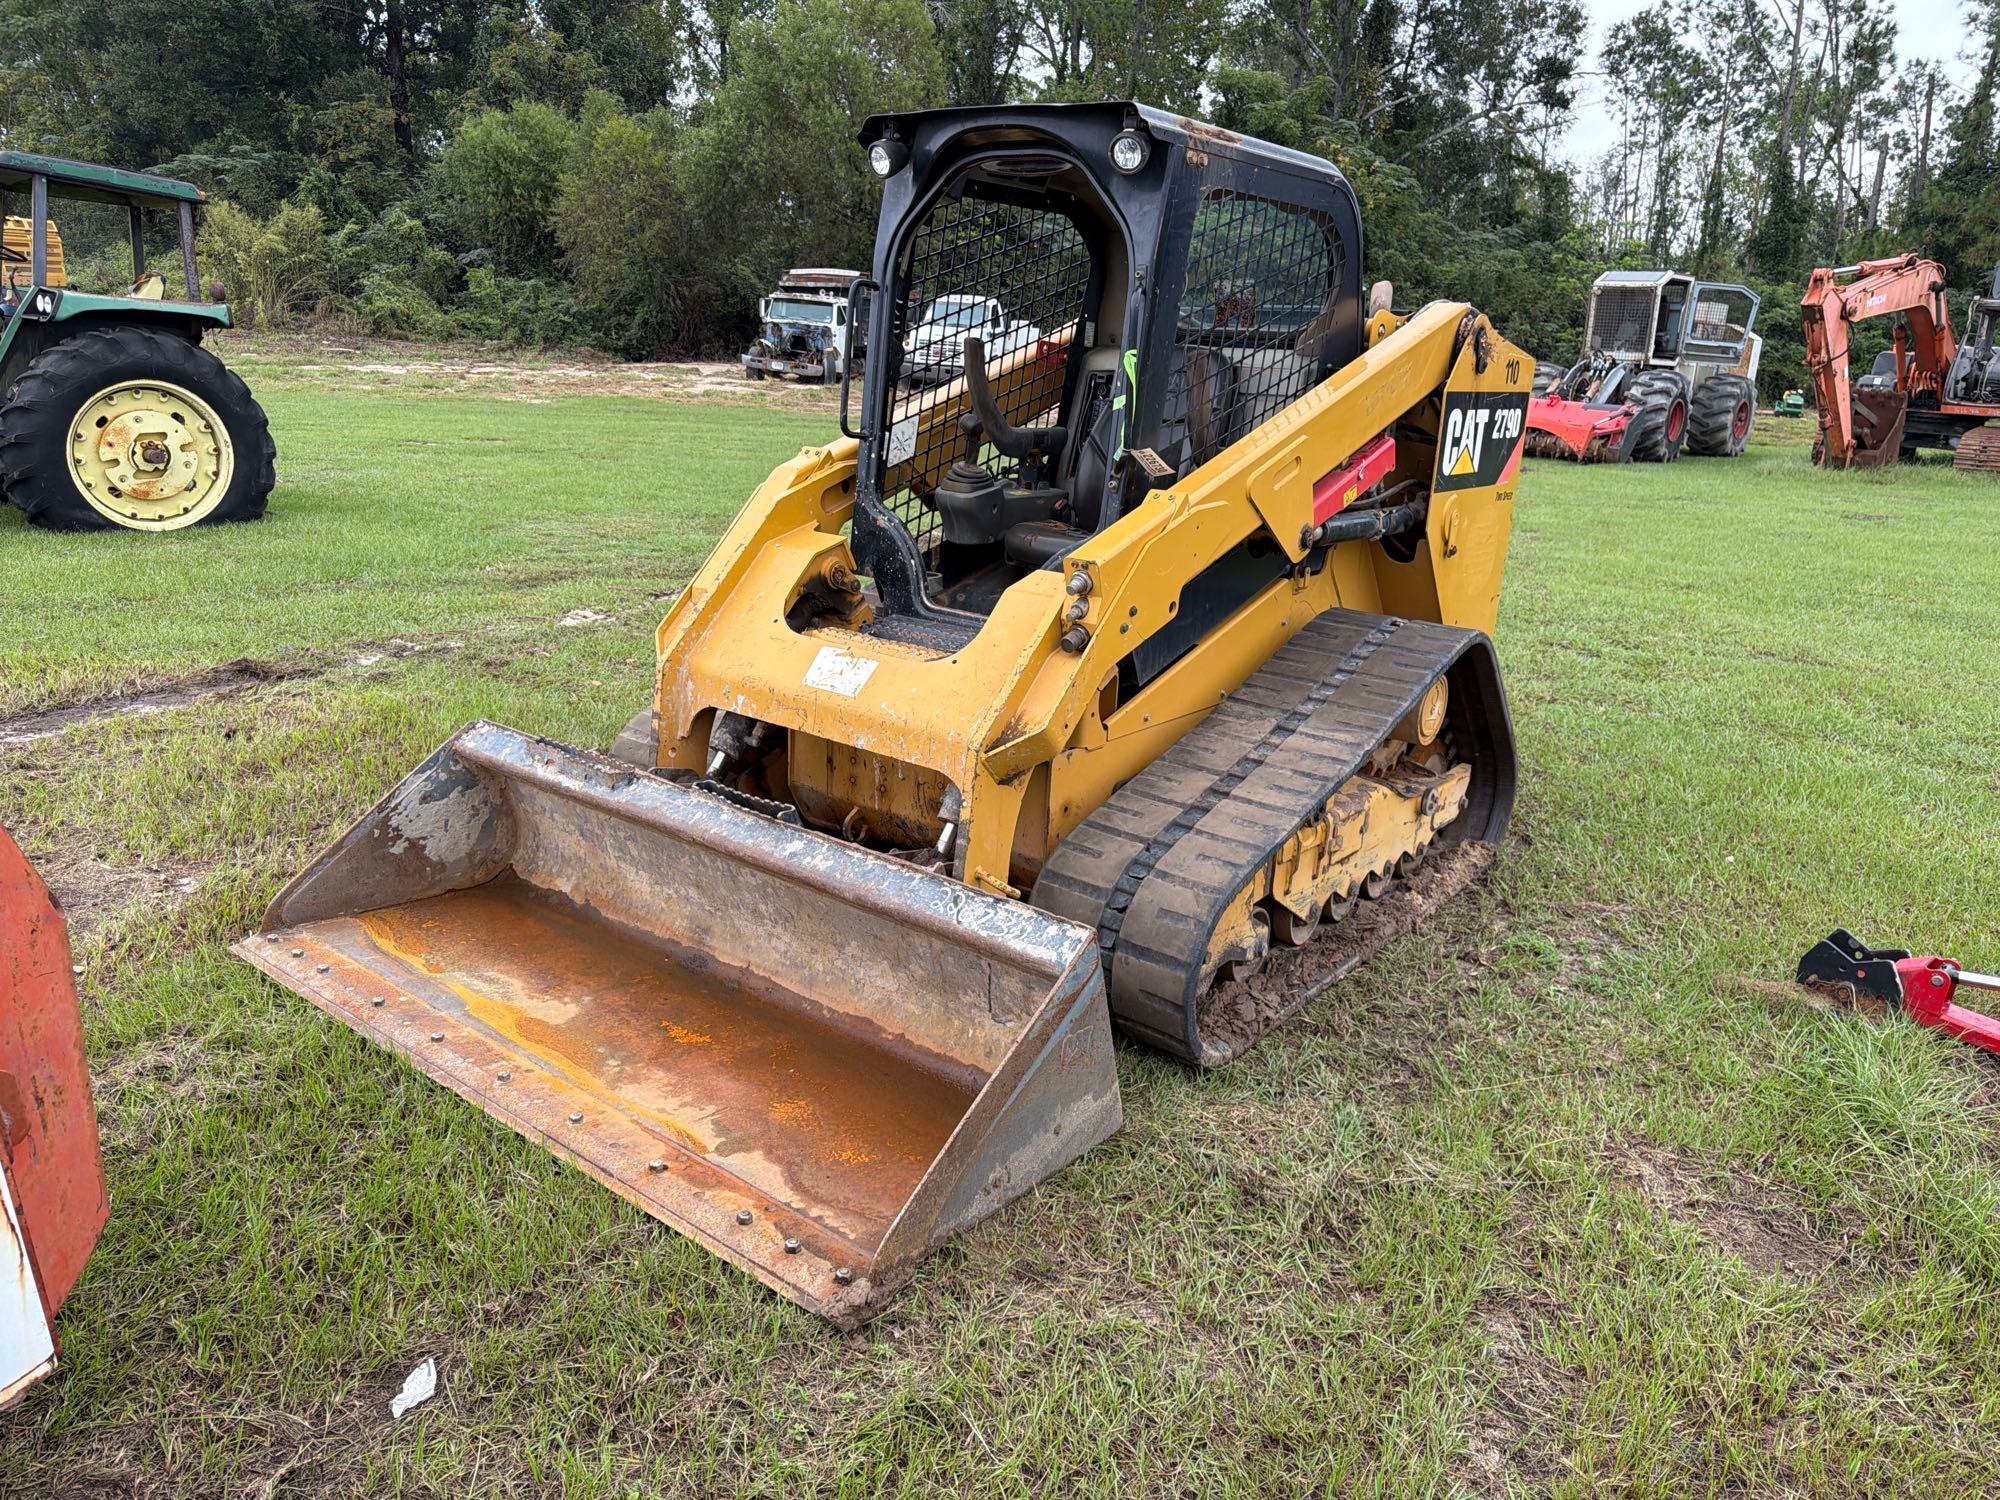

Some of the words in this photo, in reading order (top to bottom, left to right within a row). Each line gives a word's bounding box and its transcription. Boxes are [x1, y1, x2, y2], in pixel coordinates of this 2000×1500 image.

[1505, 358, 1520, 385] 110
[1442, 408, 1490, 477] CAT
[1492, 408, 1522, 439] 279D
